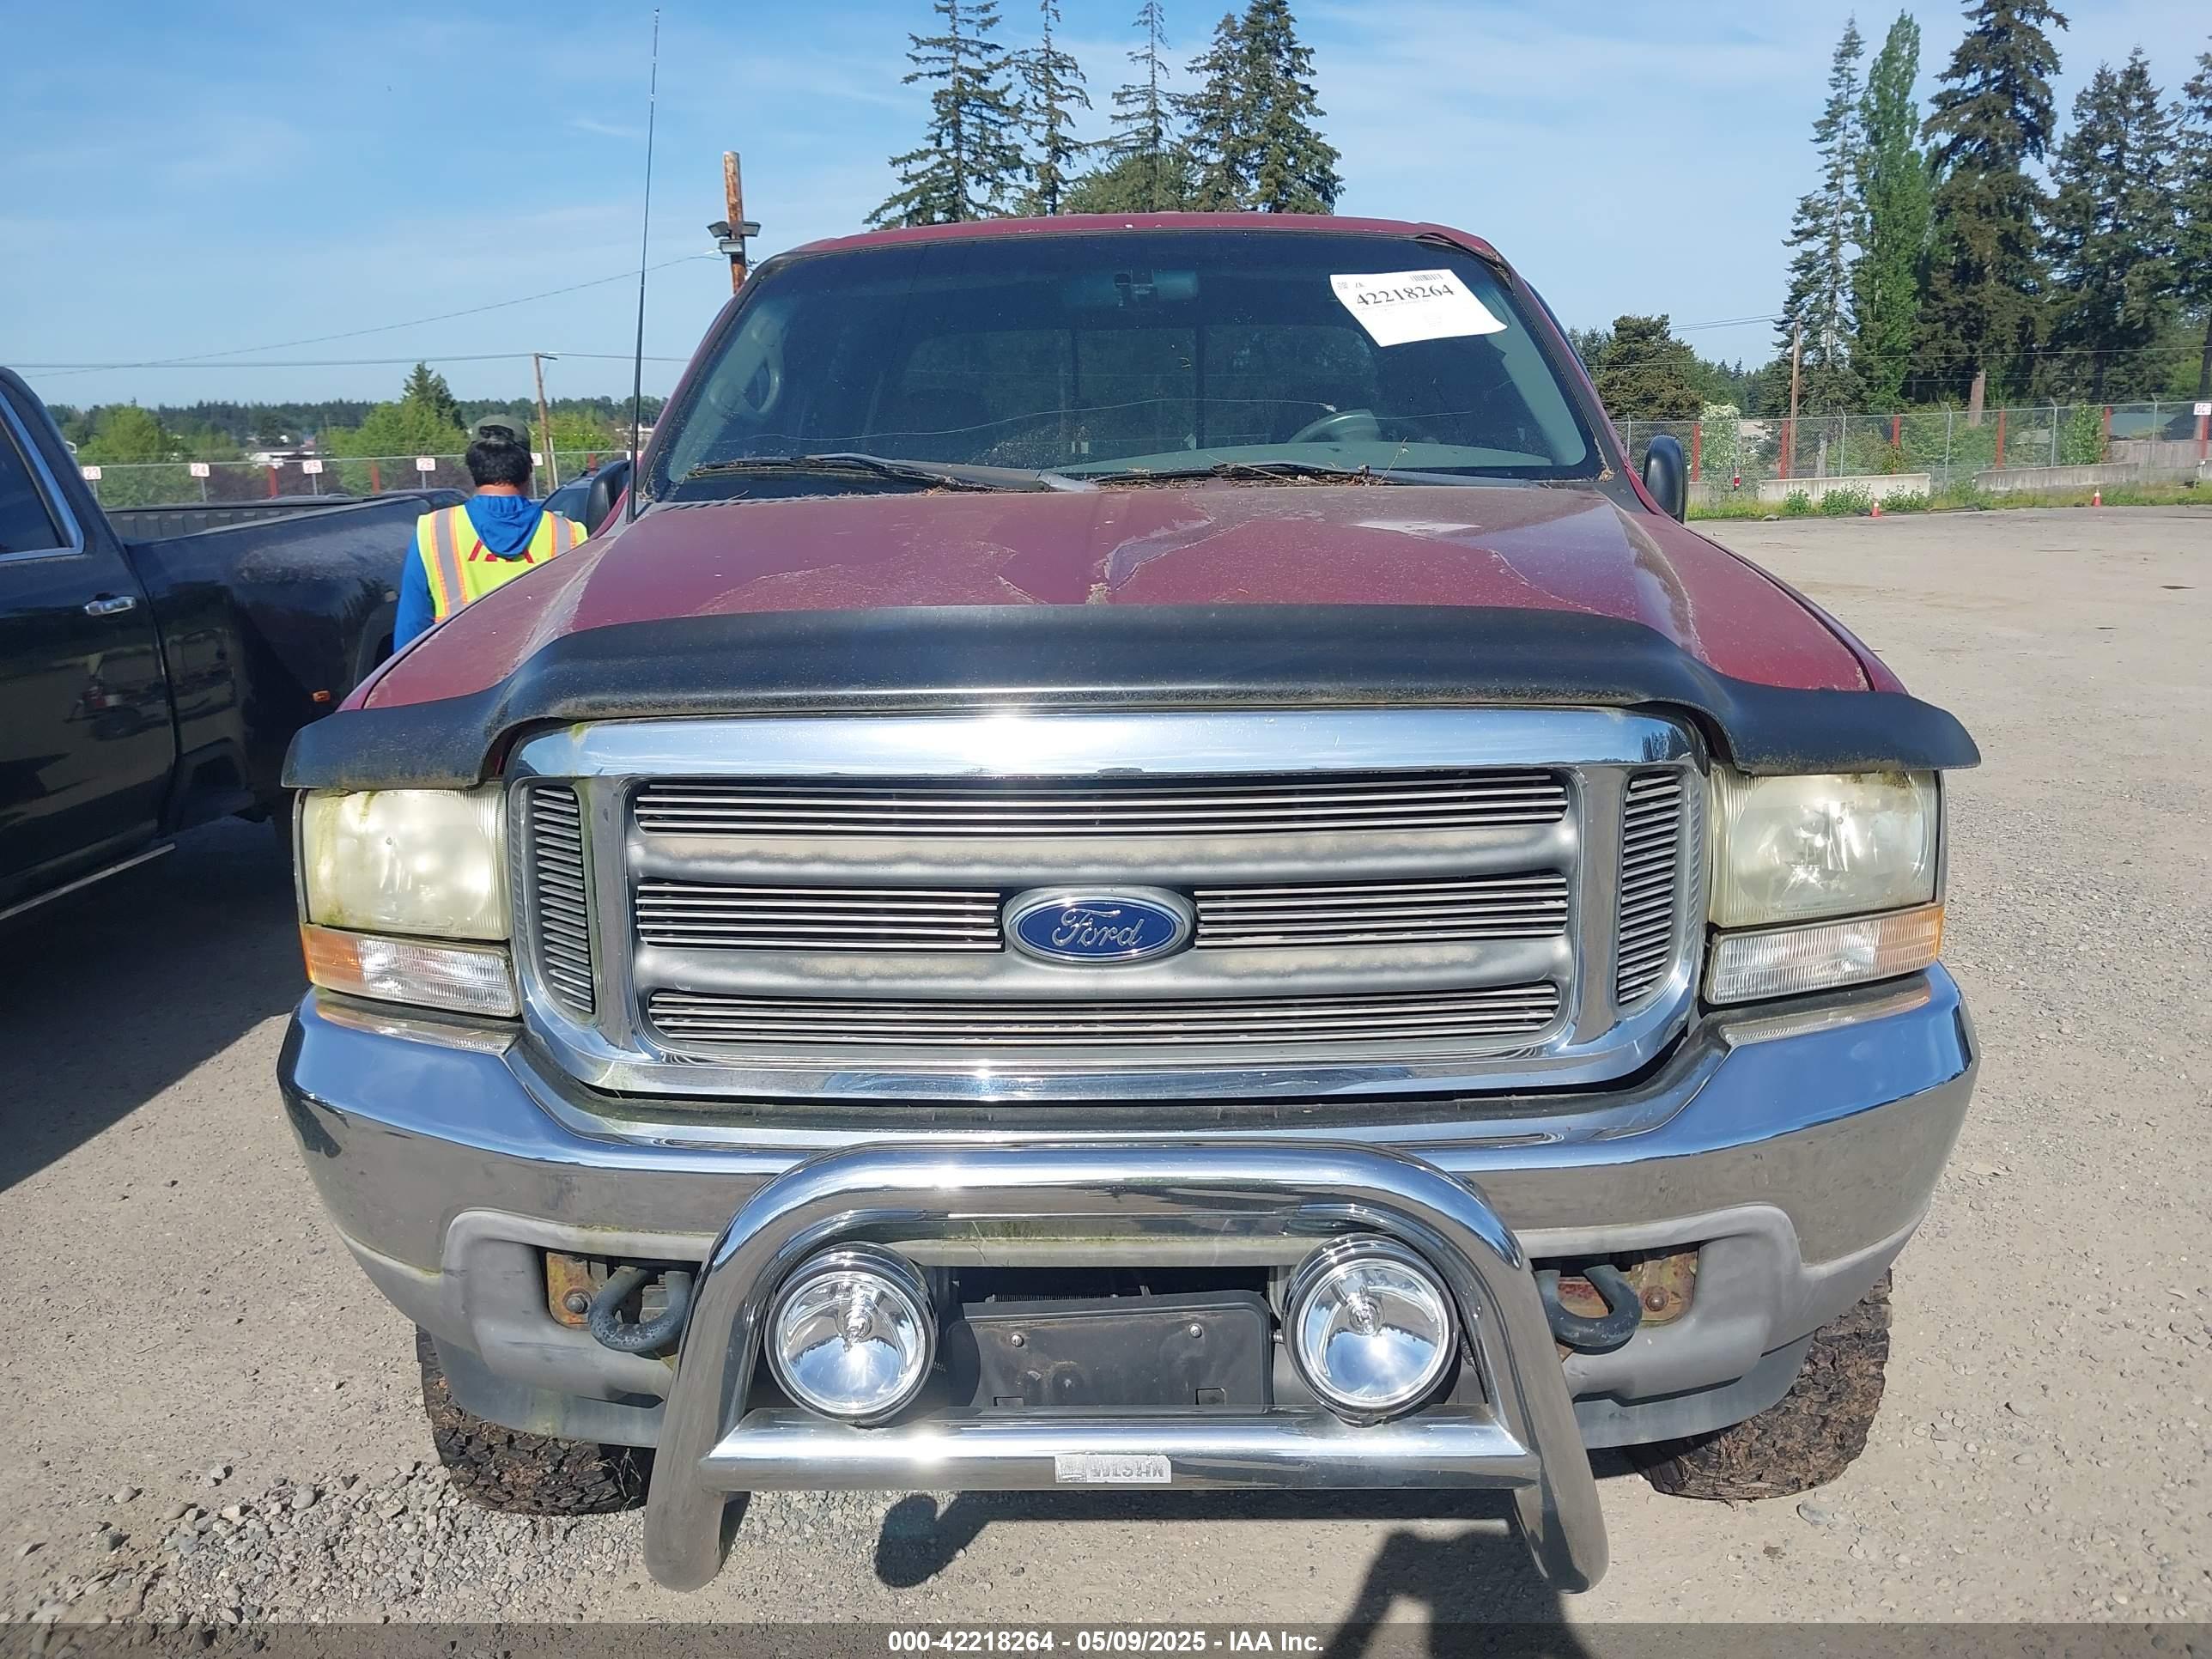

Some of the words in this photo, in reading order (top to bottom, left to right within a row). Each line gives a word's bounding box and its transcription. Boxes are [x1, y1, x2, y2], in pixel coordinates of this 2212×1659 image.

[1357, 284, 1455, 305] 42218264
[305, 461, 320, 473] 25
[419, 459, 434, 470] 26
[86, 468, 99, 478] 23
[192, 465, 207, 476] 24
[1051, 908, 1146, 948] Ford
